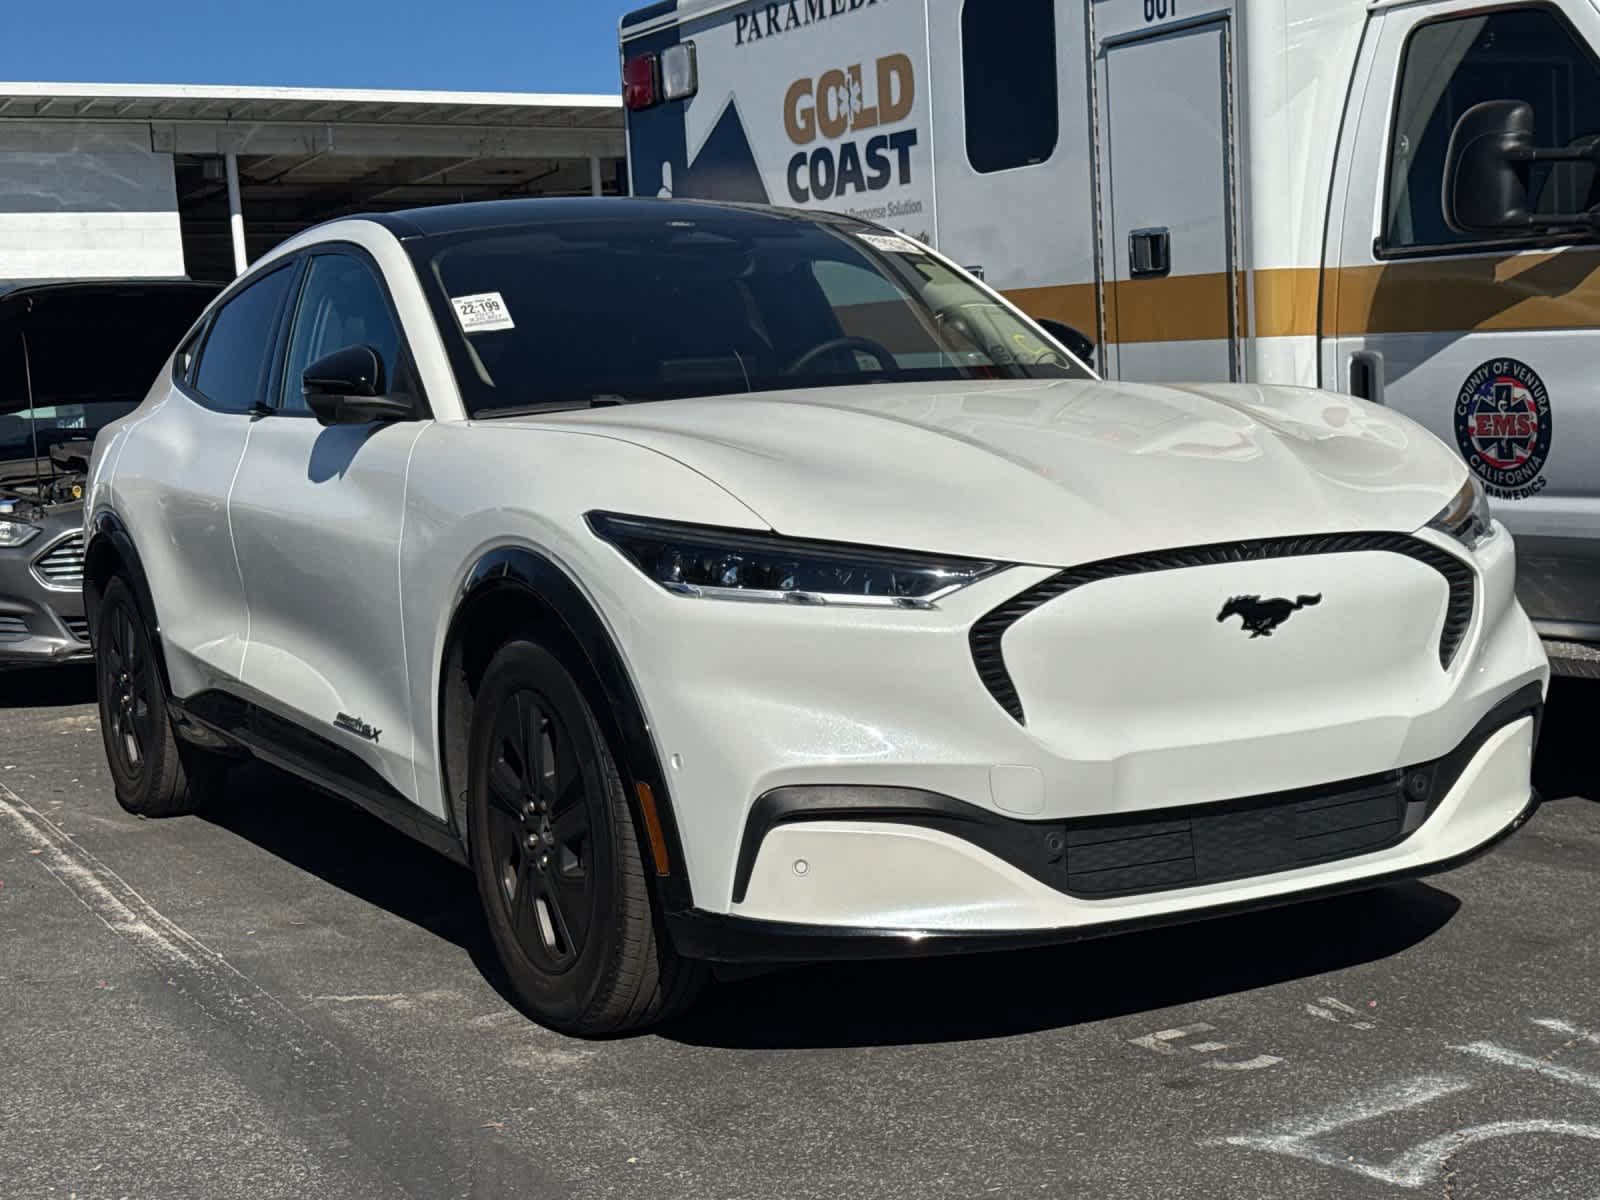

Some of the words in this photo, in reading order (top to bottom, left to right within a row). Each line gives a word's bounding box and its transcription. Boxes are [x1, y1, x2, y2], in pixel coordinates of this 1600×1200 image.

[783, 53, 915, 146] GOLD
[787, 128, 918, 204] COAST
[887, 200, 923, 217] Solution
[1457, 367, 1489, 416] COUNTY
[1493, 362, 1509, 374] OF
[1513, 364, 1548, 416] VENTURA
[1475, 414, 1531, 436] EMS
[1470, 455, 1541, 484] CALIFORNIA
[1480, 476, 1547, 500] RAMEDICS
